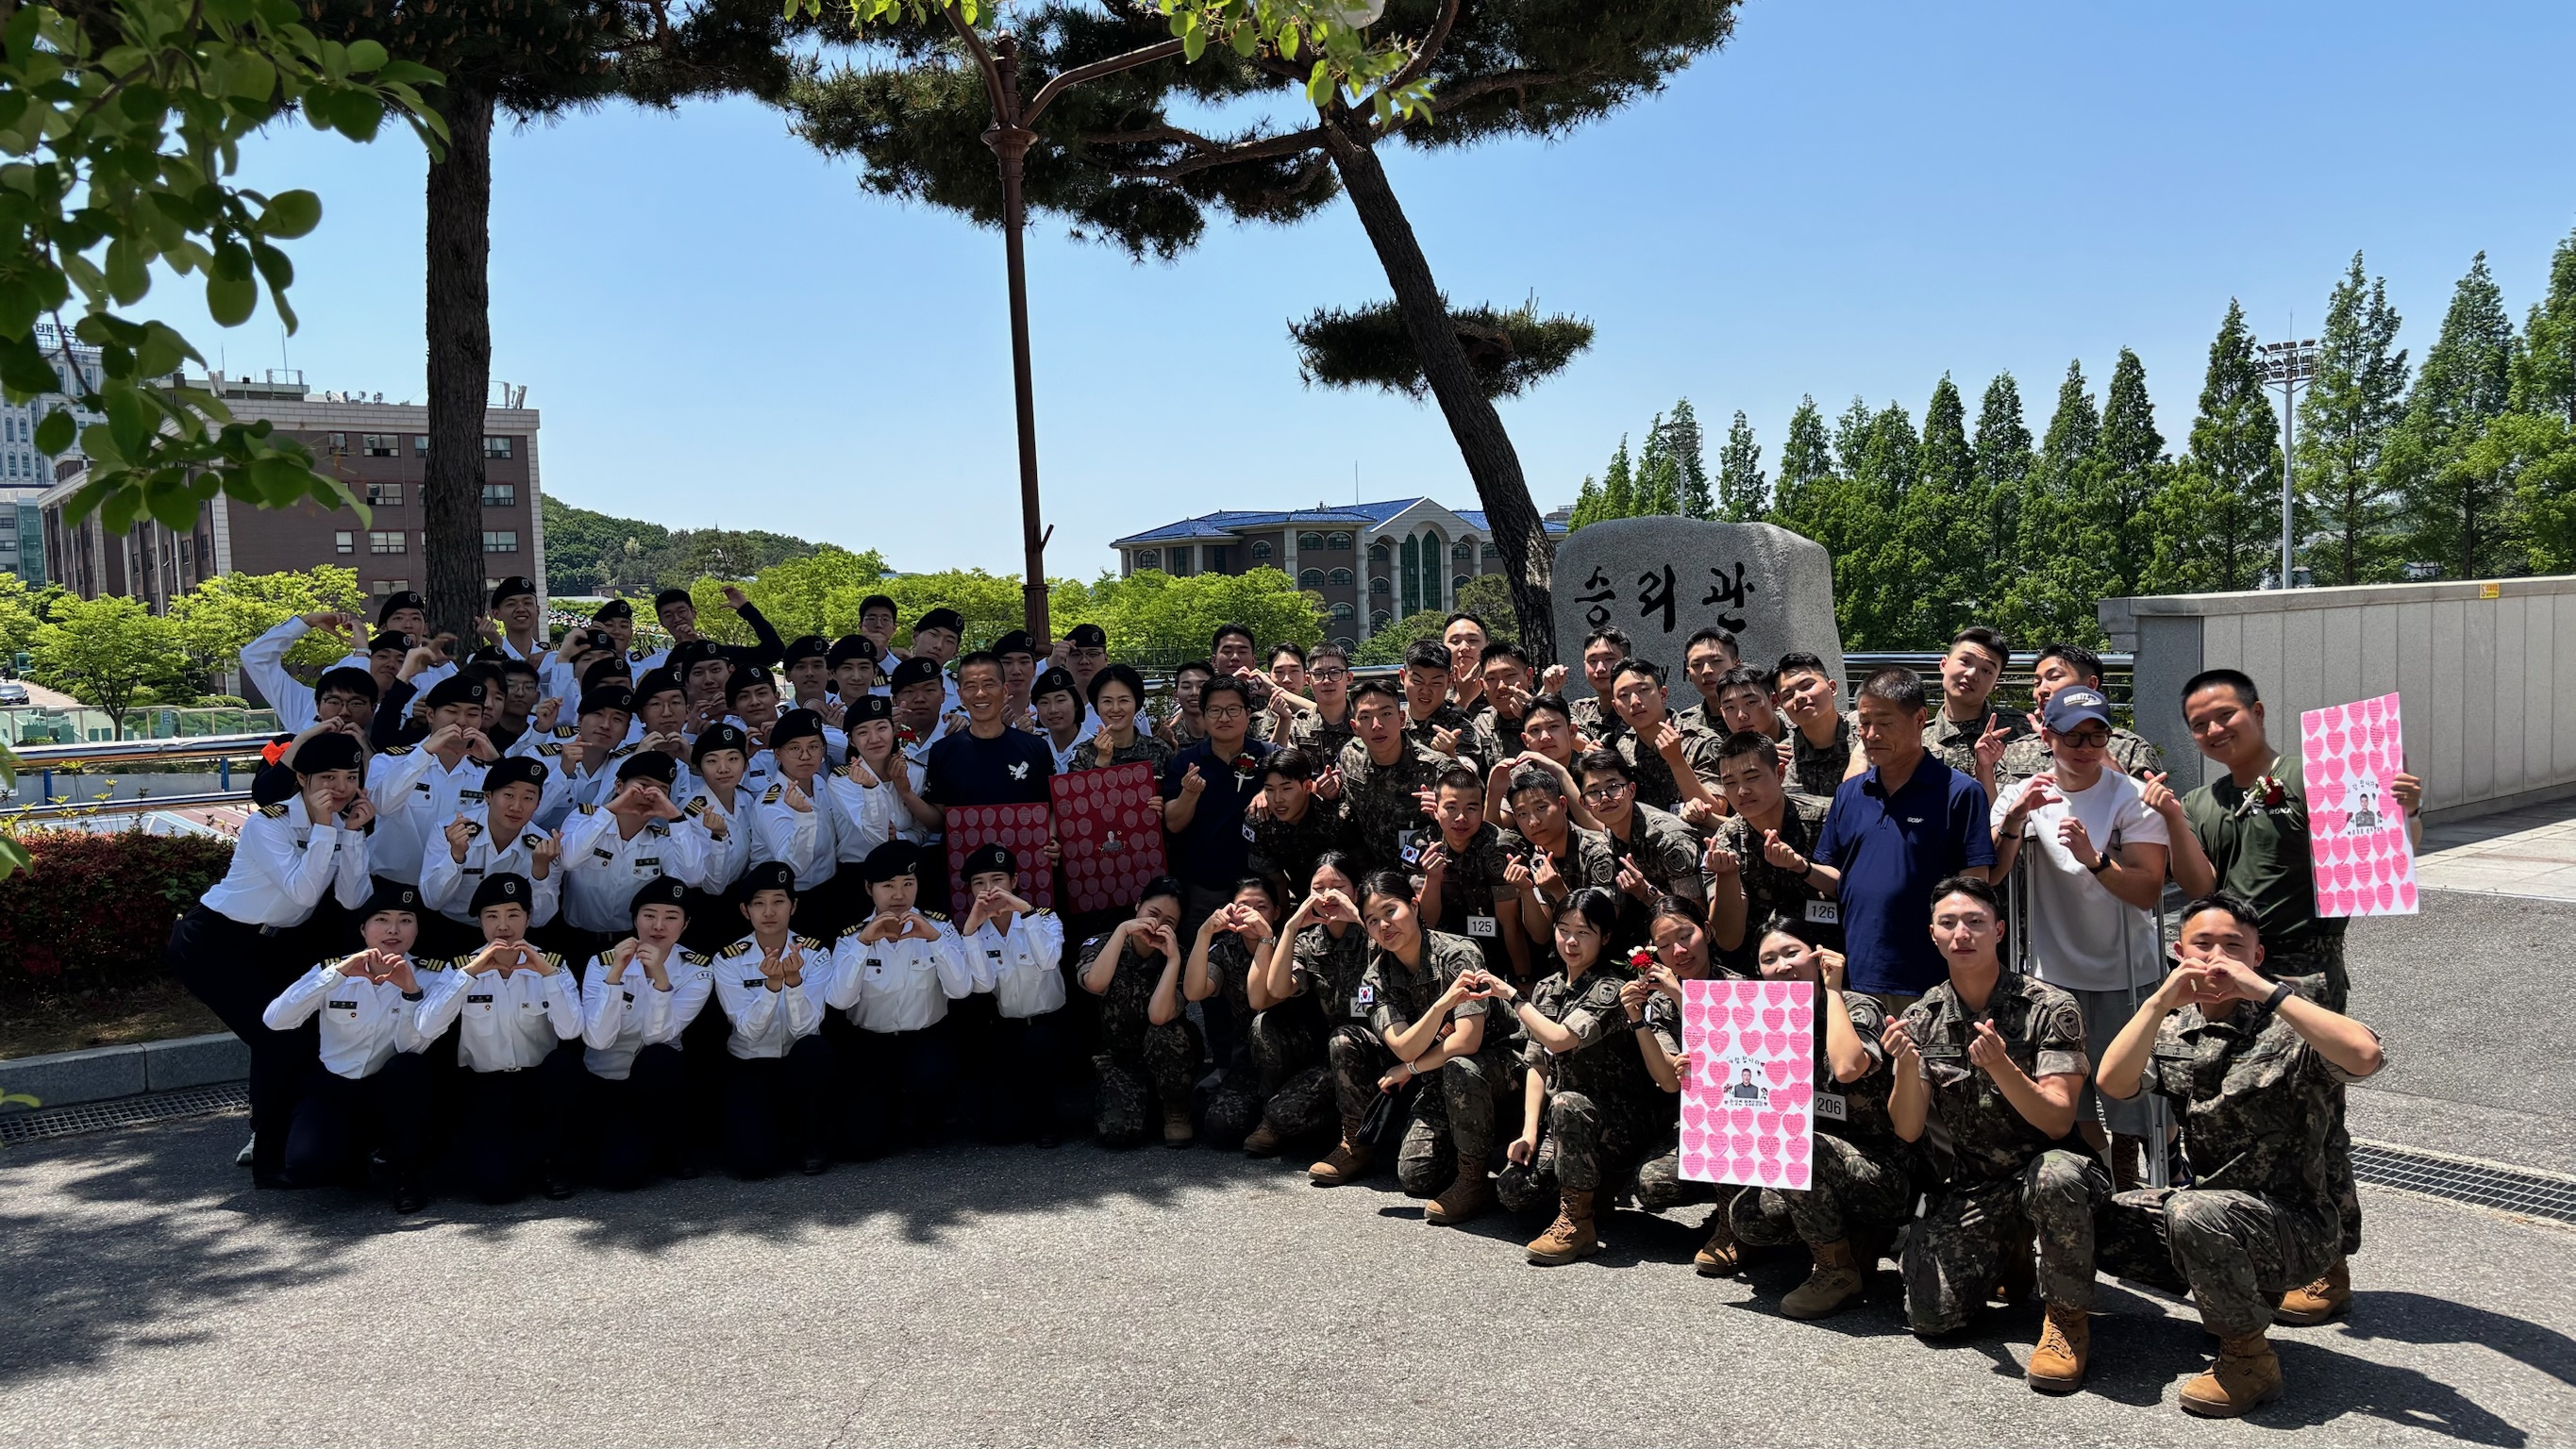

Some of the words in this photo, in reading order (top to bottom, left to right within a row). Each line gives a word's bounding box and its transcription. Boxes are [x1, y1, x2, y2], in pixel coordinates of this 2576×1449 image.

[1574, 561, 1755, 634] 승리관
[1812, 905, 1835, 920] 126
[1472, 920, 1492, 933] 125
[1817, 1097, 1841, 1115] 206
